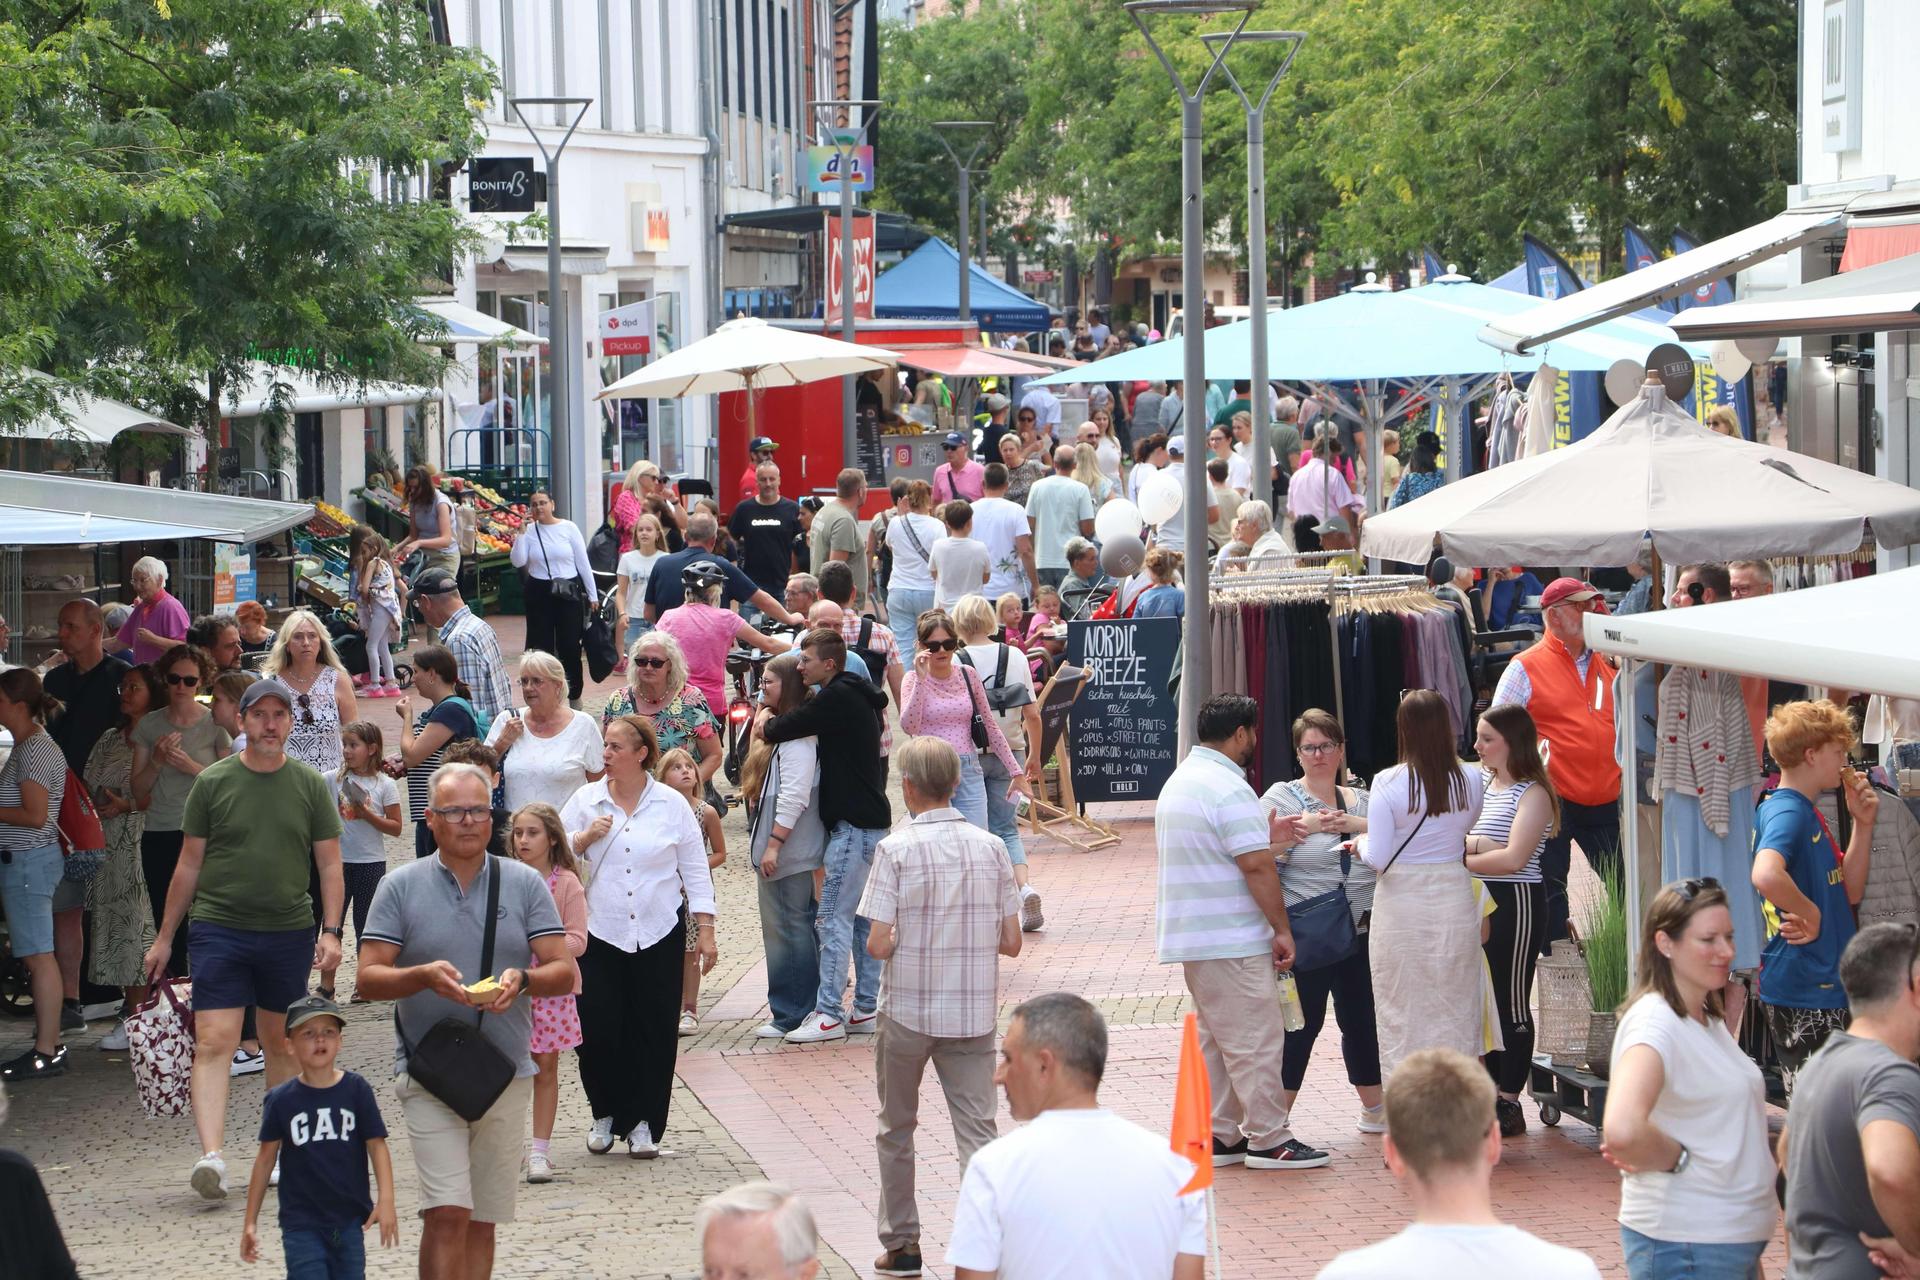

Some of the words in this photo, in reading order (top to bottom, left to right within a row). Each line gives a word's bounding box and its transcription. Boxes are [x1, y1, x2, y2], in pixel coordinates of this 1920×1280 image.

[472, 181, 511, 191] BONITA
[622, 319, 638, 328] dpd
[609, 341, 642, 351] Pickup
[1083, 656, 1147, 686] BREEZE
[1118, 686, 1158, 707] kuschelig
[1107, 700, 1130, 714] mit
[1113, 717, 1133, 730] OPUS
[1137, 717, 1167, 731] PANTS
[1083, 732, 1104, 743] OPUS
[1111, 730, 1141, 743] STREET
[1143, 732, 1161, 745] ONE
[1149, 748, 1171, 759] BLACK
[1083, 765, 1097, 776] JDY
[1131, 763, 1149, 776] ONLY
[1116, 782, 1133, 791] HOLD
[290, 1107, 356, 1147] GAP
